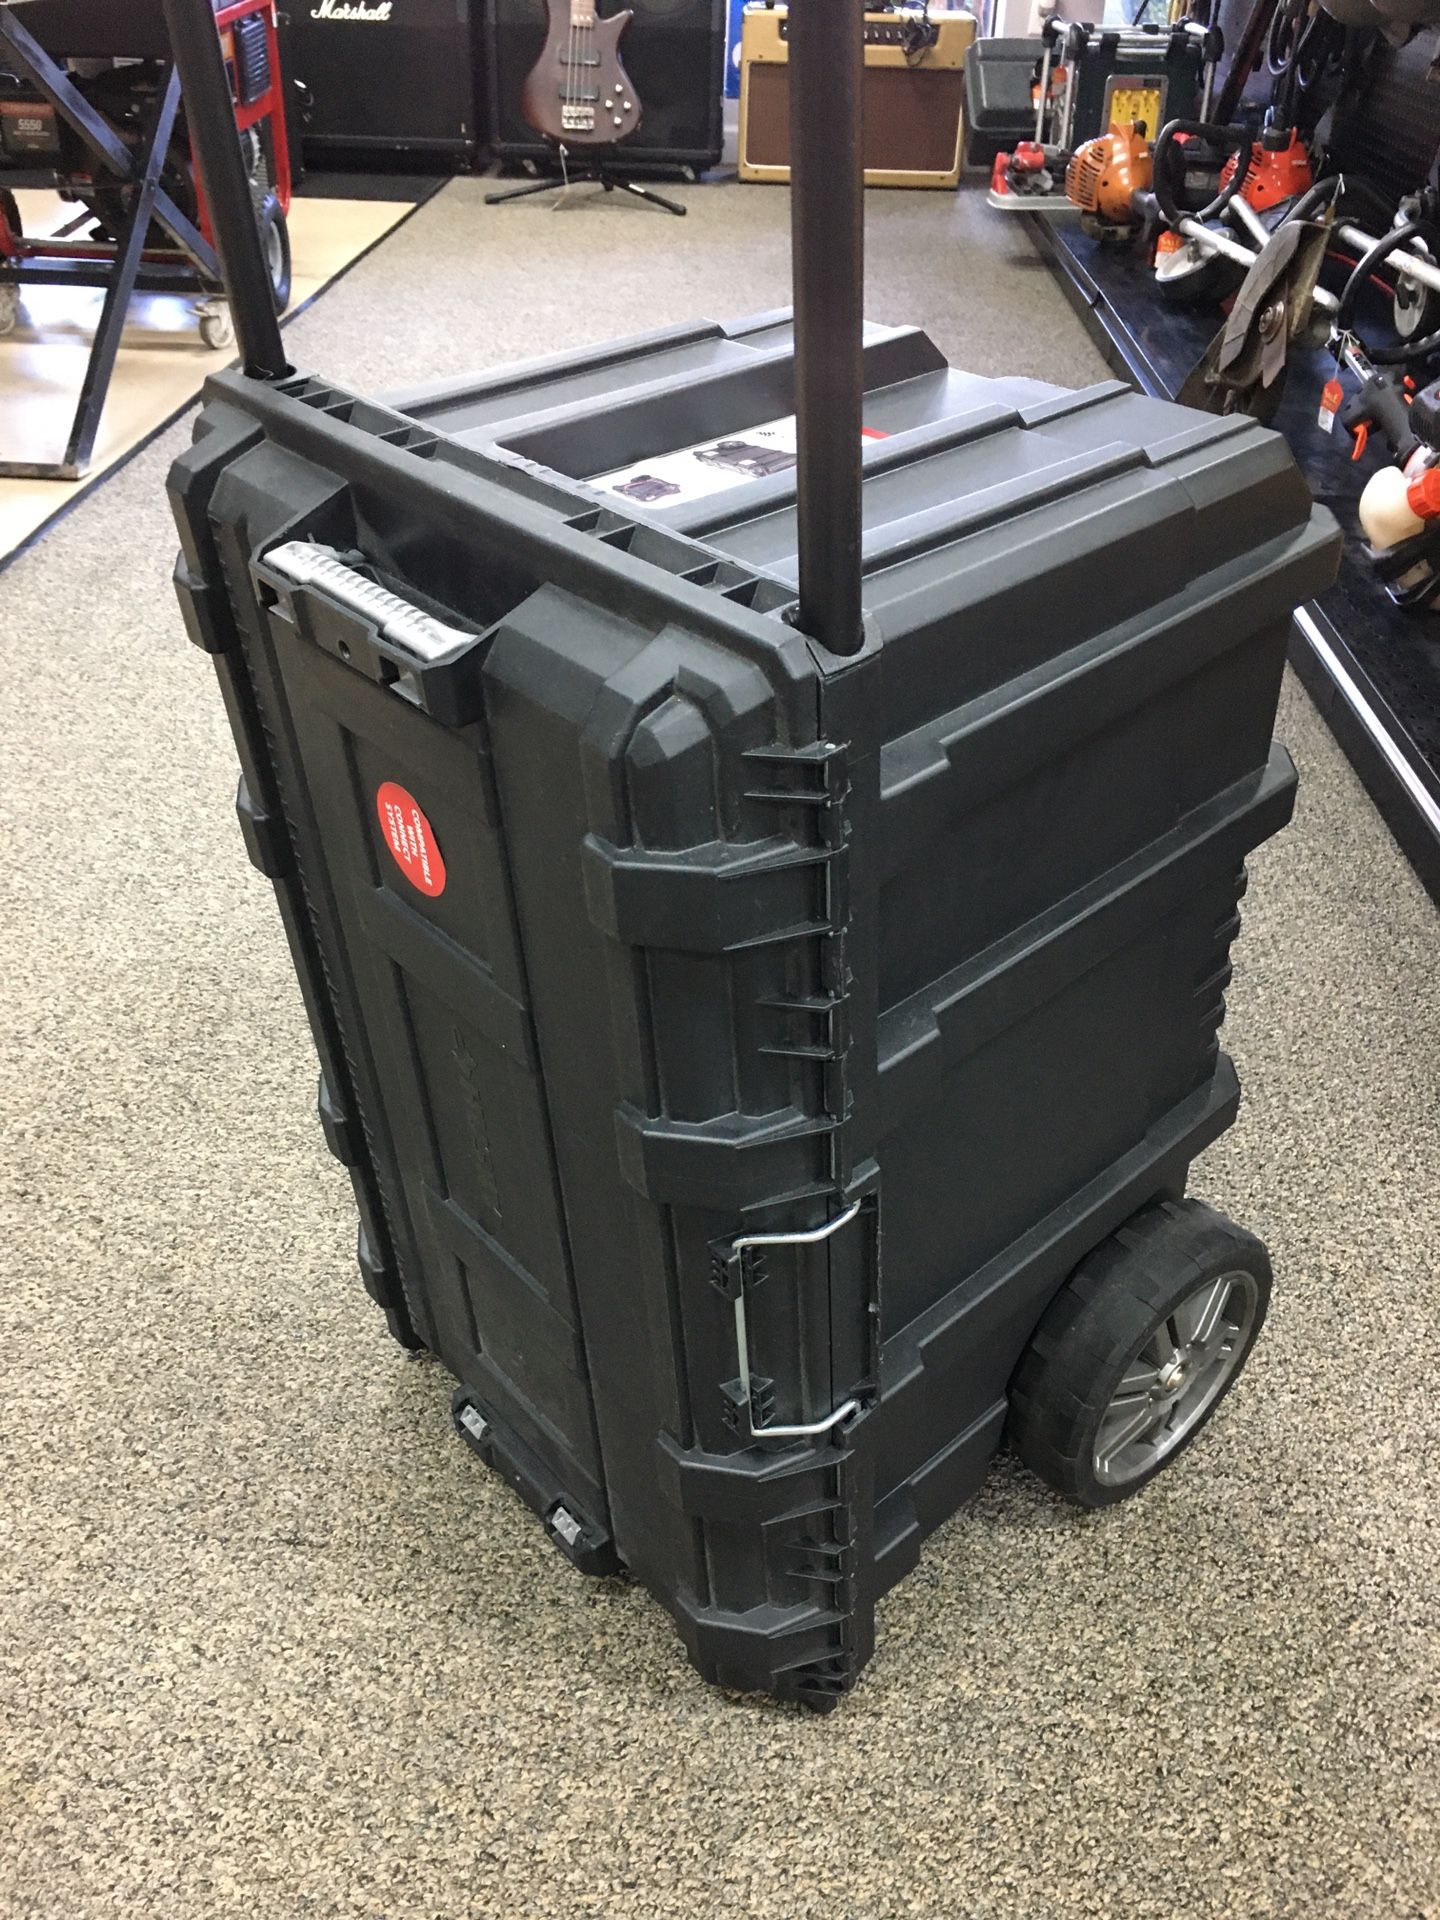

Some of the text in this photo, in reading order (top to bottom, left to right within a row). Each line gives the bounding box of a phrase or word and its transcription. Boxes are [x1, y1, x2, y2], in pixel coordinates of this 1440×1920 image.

[310, 0, 393, 20] Marshall
[385, 801, 402, 853] SYSTEM
[394, 804, 412, 864] CONNECT
[407, 824, 419, 857] WITH
[412, 808, 433, 886] COMPATIBLE
